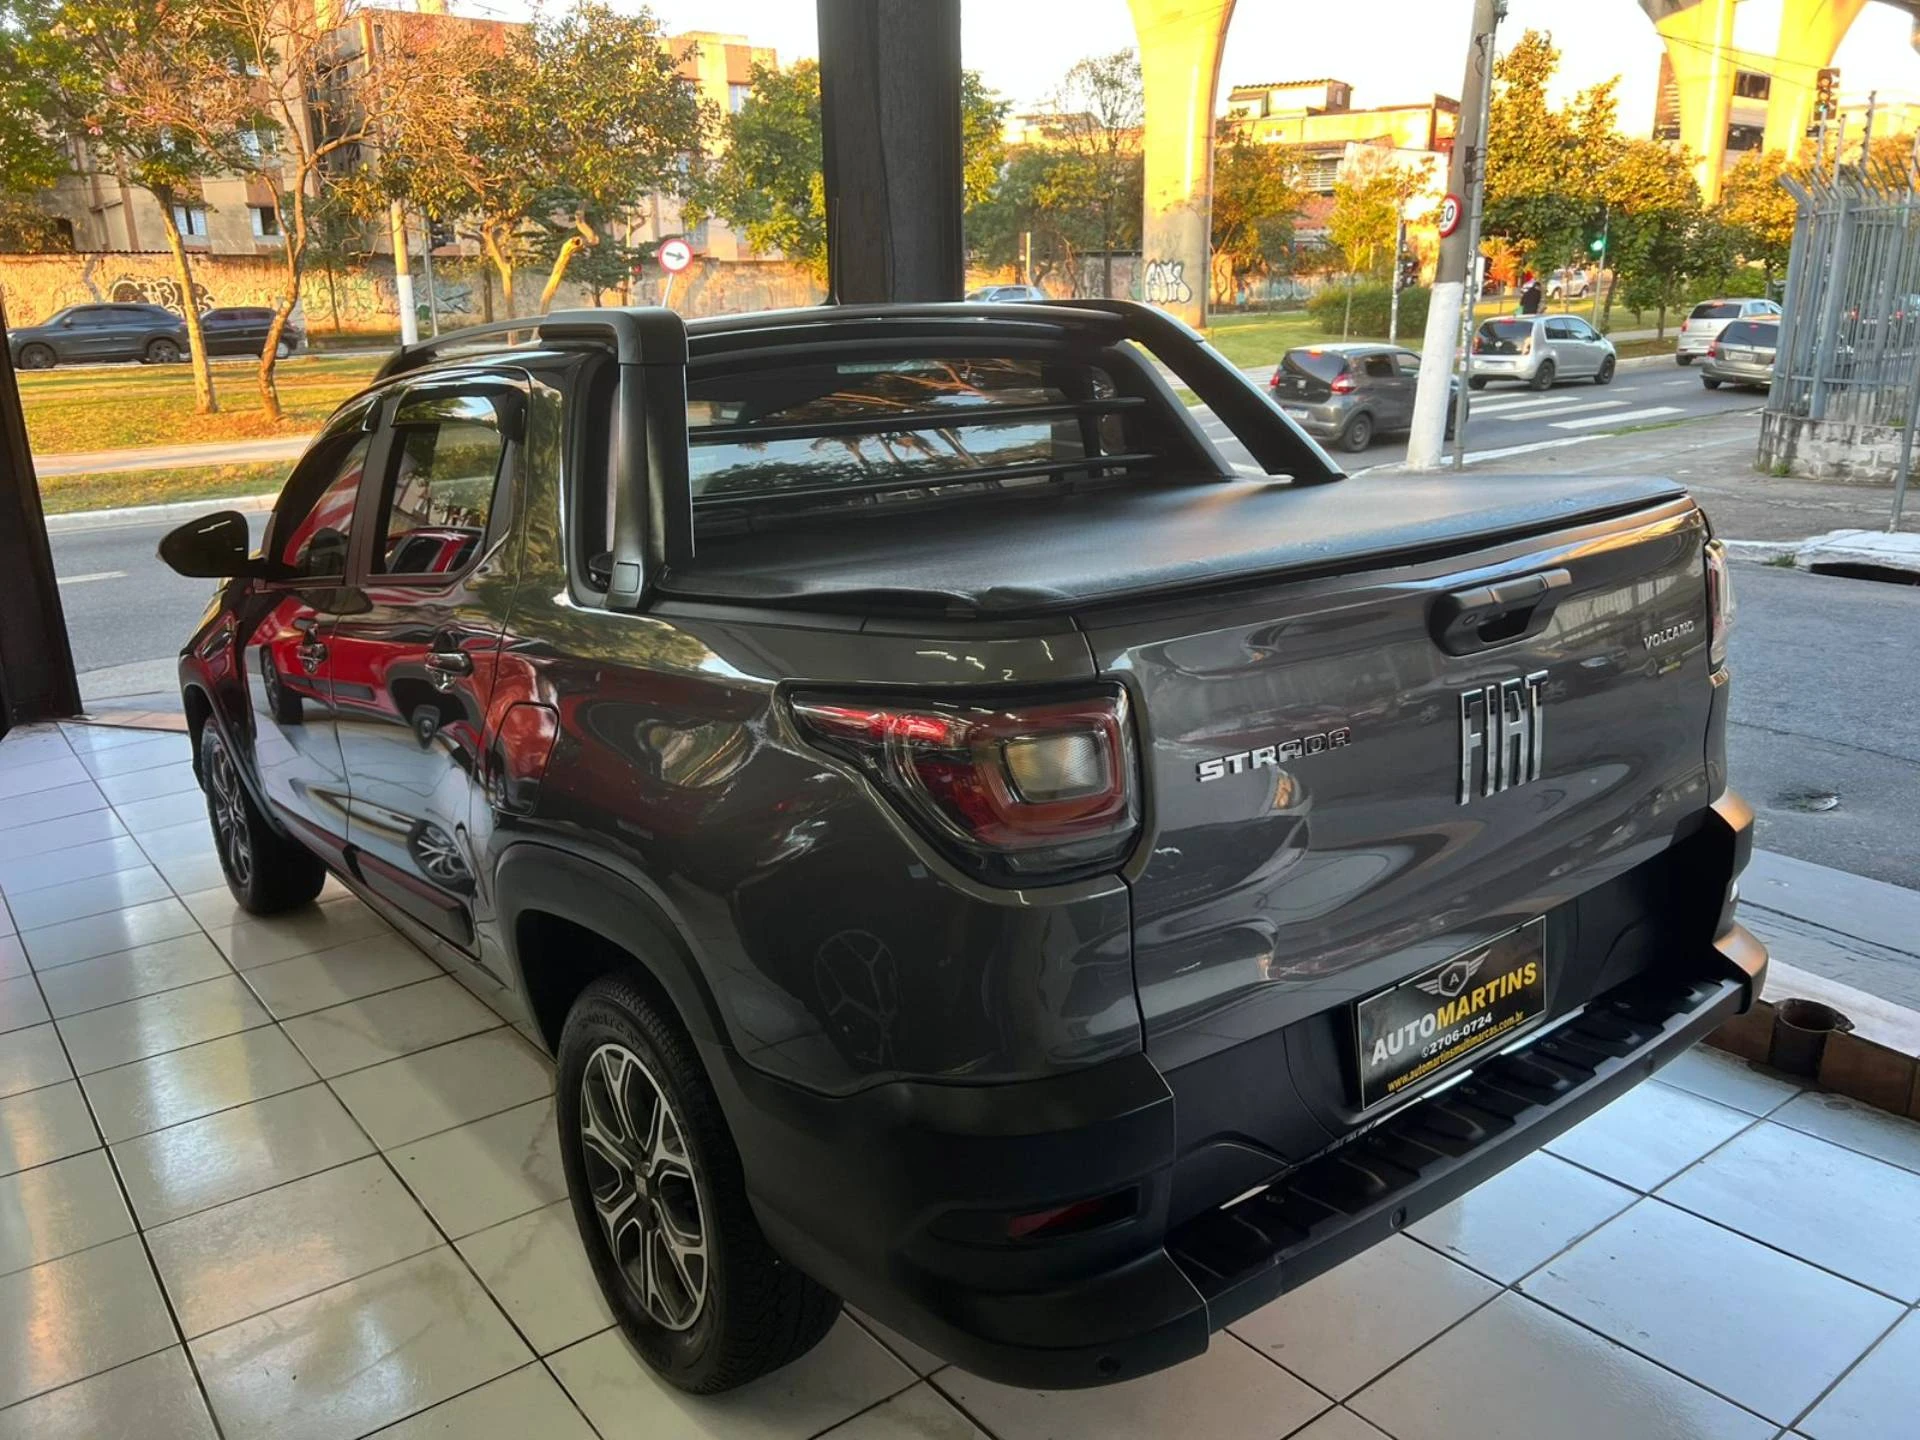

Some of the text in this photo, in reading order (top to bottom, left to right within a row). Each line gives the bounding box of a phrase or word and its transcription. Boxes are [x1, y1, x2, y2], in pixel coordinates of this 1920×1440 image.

[1643, 620, 1695, 650] VOLCANO
[1197, 726, 1350, 782] STRADA
[1458, 670, 1549, 805] FIAT
[1428, 1012, 1493, 1056] 2706-0724
